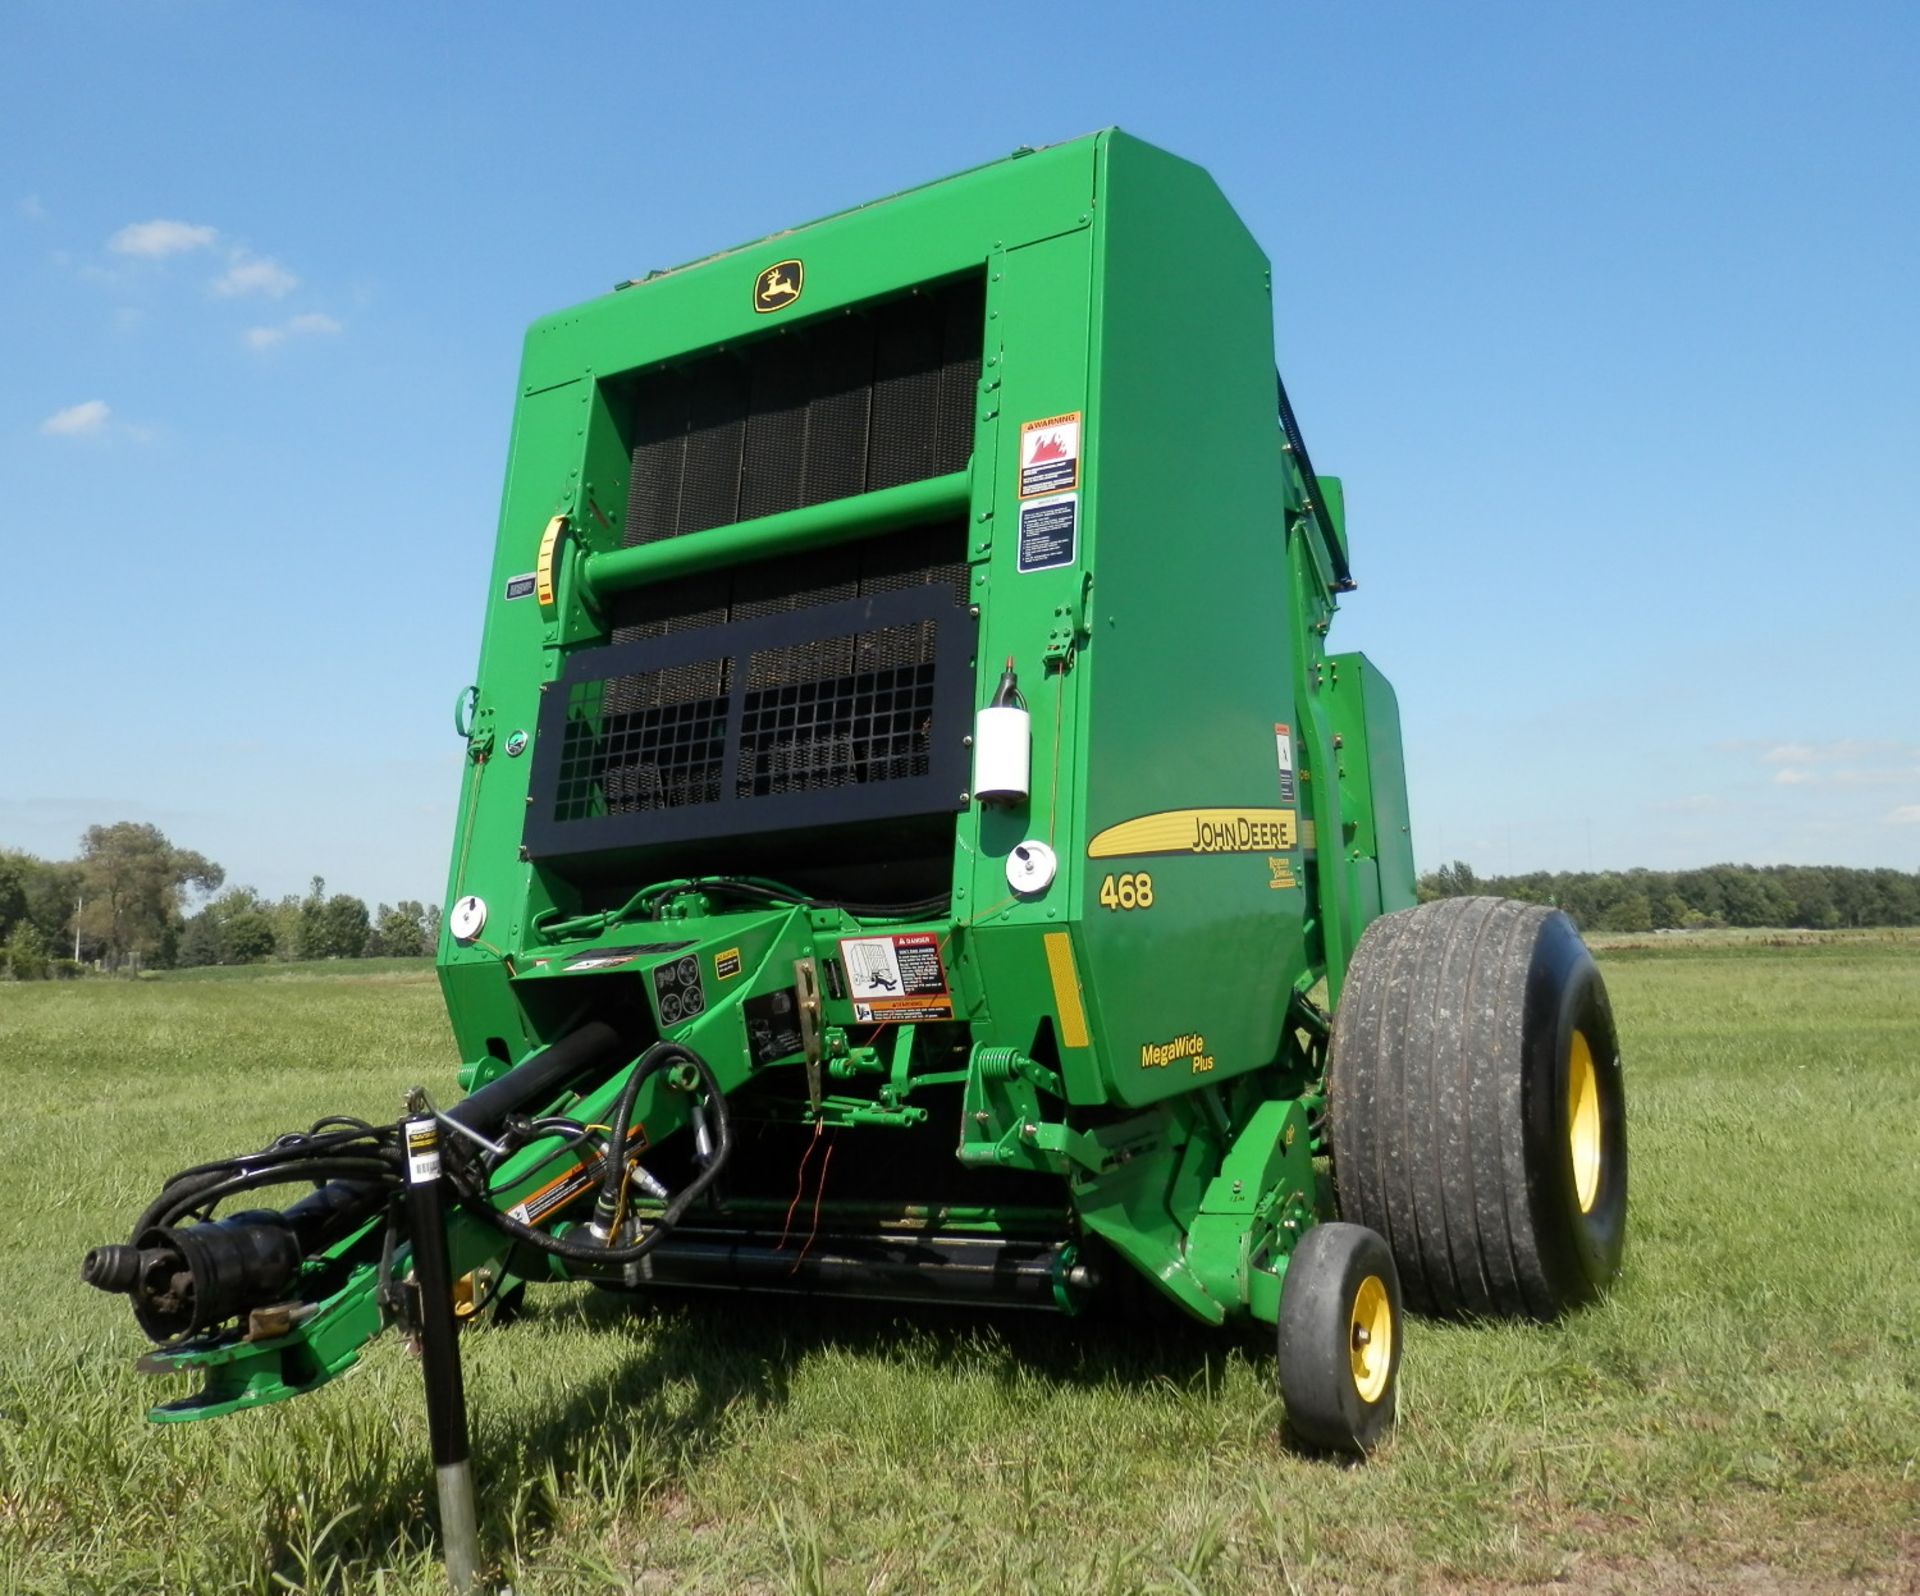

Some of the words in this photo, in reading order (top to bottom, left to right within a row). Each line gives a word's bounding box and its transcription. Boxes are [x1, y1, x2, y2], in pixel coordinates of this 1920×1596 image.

[1033, 414, 1075, 429] WARNING
[1192, 817, 1237, 848] JOHN
[1237, 817, 1289, 847] DEERE
[1100, 872, 1153, 910] 468
[906, 936, 931, 944] DANGER
[1142, 1033, 1203, 1067] MegaWide
[1192, 1054, 1214, 1074] Plus
